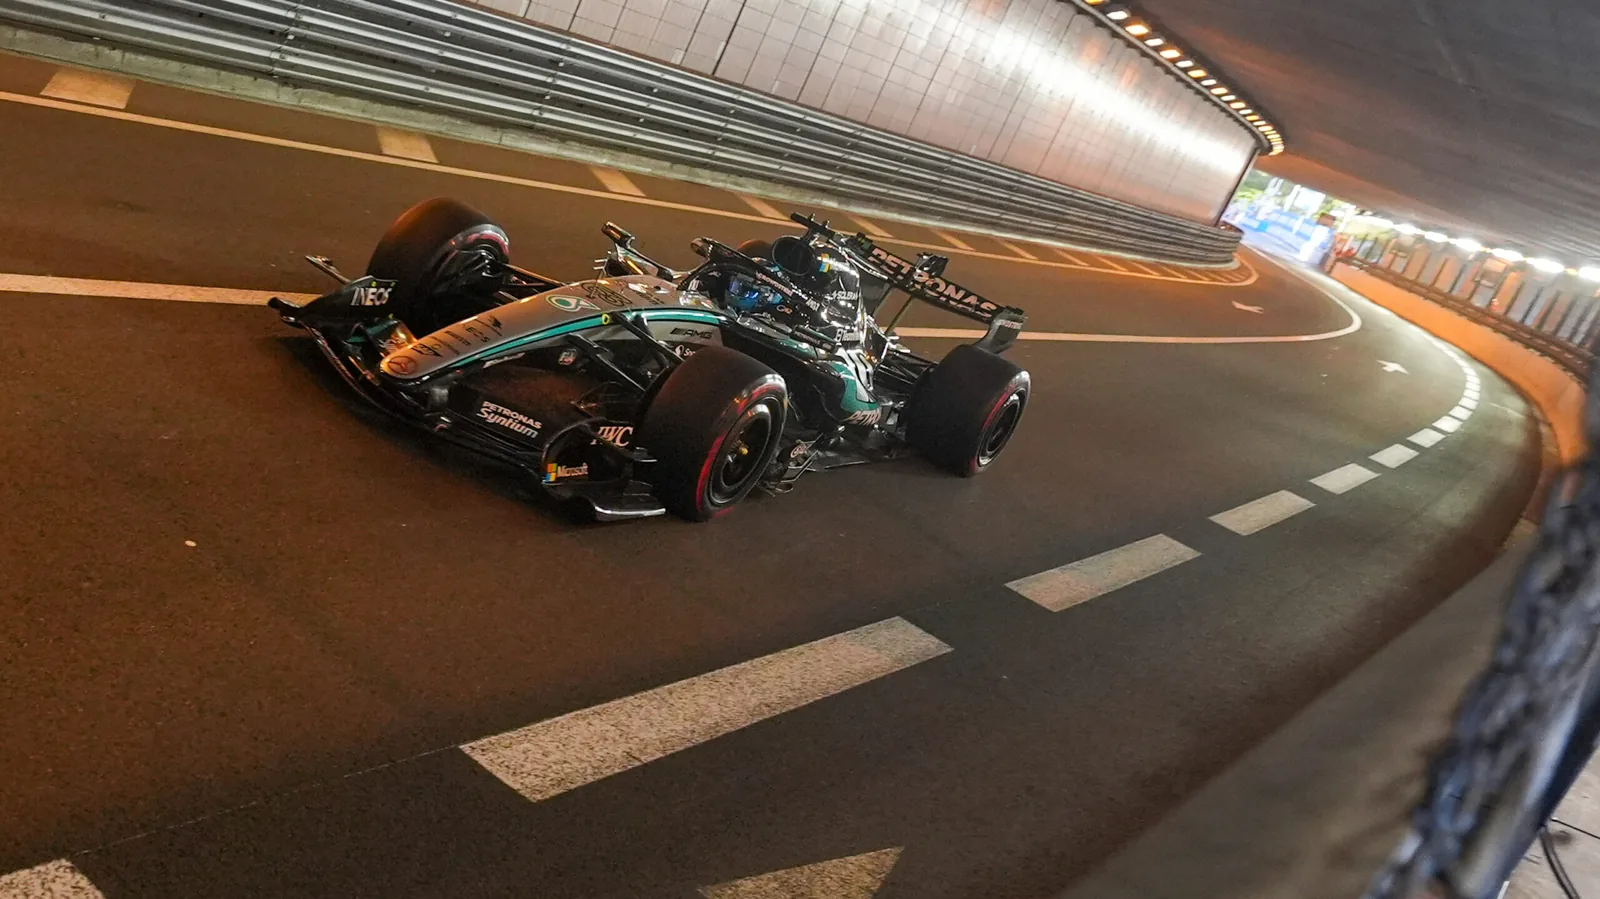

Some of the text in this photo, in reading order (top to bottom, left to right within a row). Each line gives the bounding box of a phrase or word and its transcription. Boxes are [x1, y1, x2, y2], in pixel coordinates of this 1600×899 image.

[867, 247, 997, 318] PETRONAS
[351, 287, 392, 306] INEOS
[684, 329, 712, 340] AMG
[476, 408, 539, 438] Syntium
[482, 401, 542, 429] PETRONAS
[590, 426, 634, 447] IWC
[557, 463, 588, 477] Microsoft
